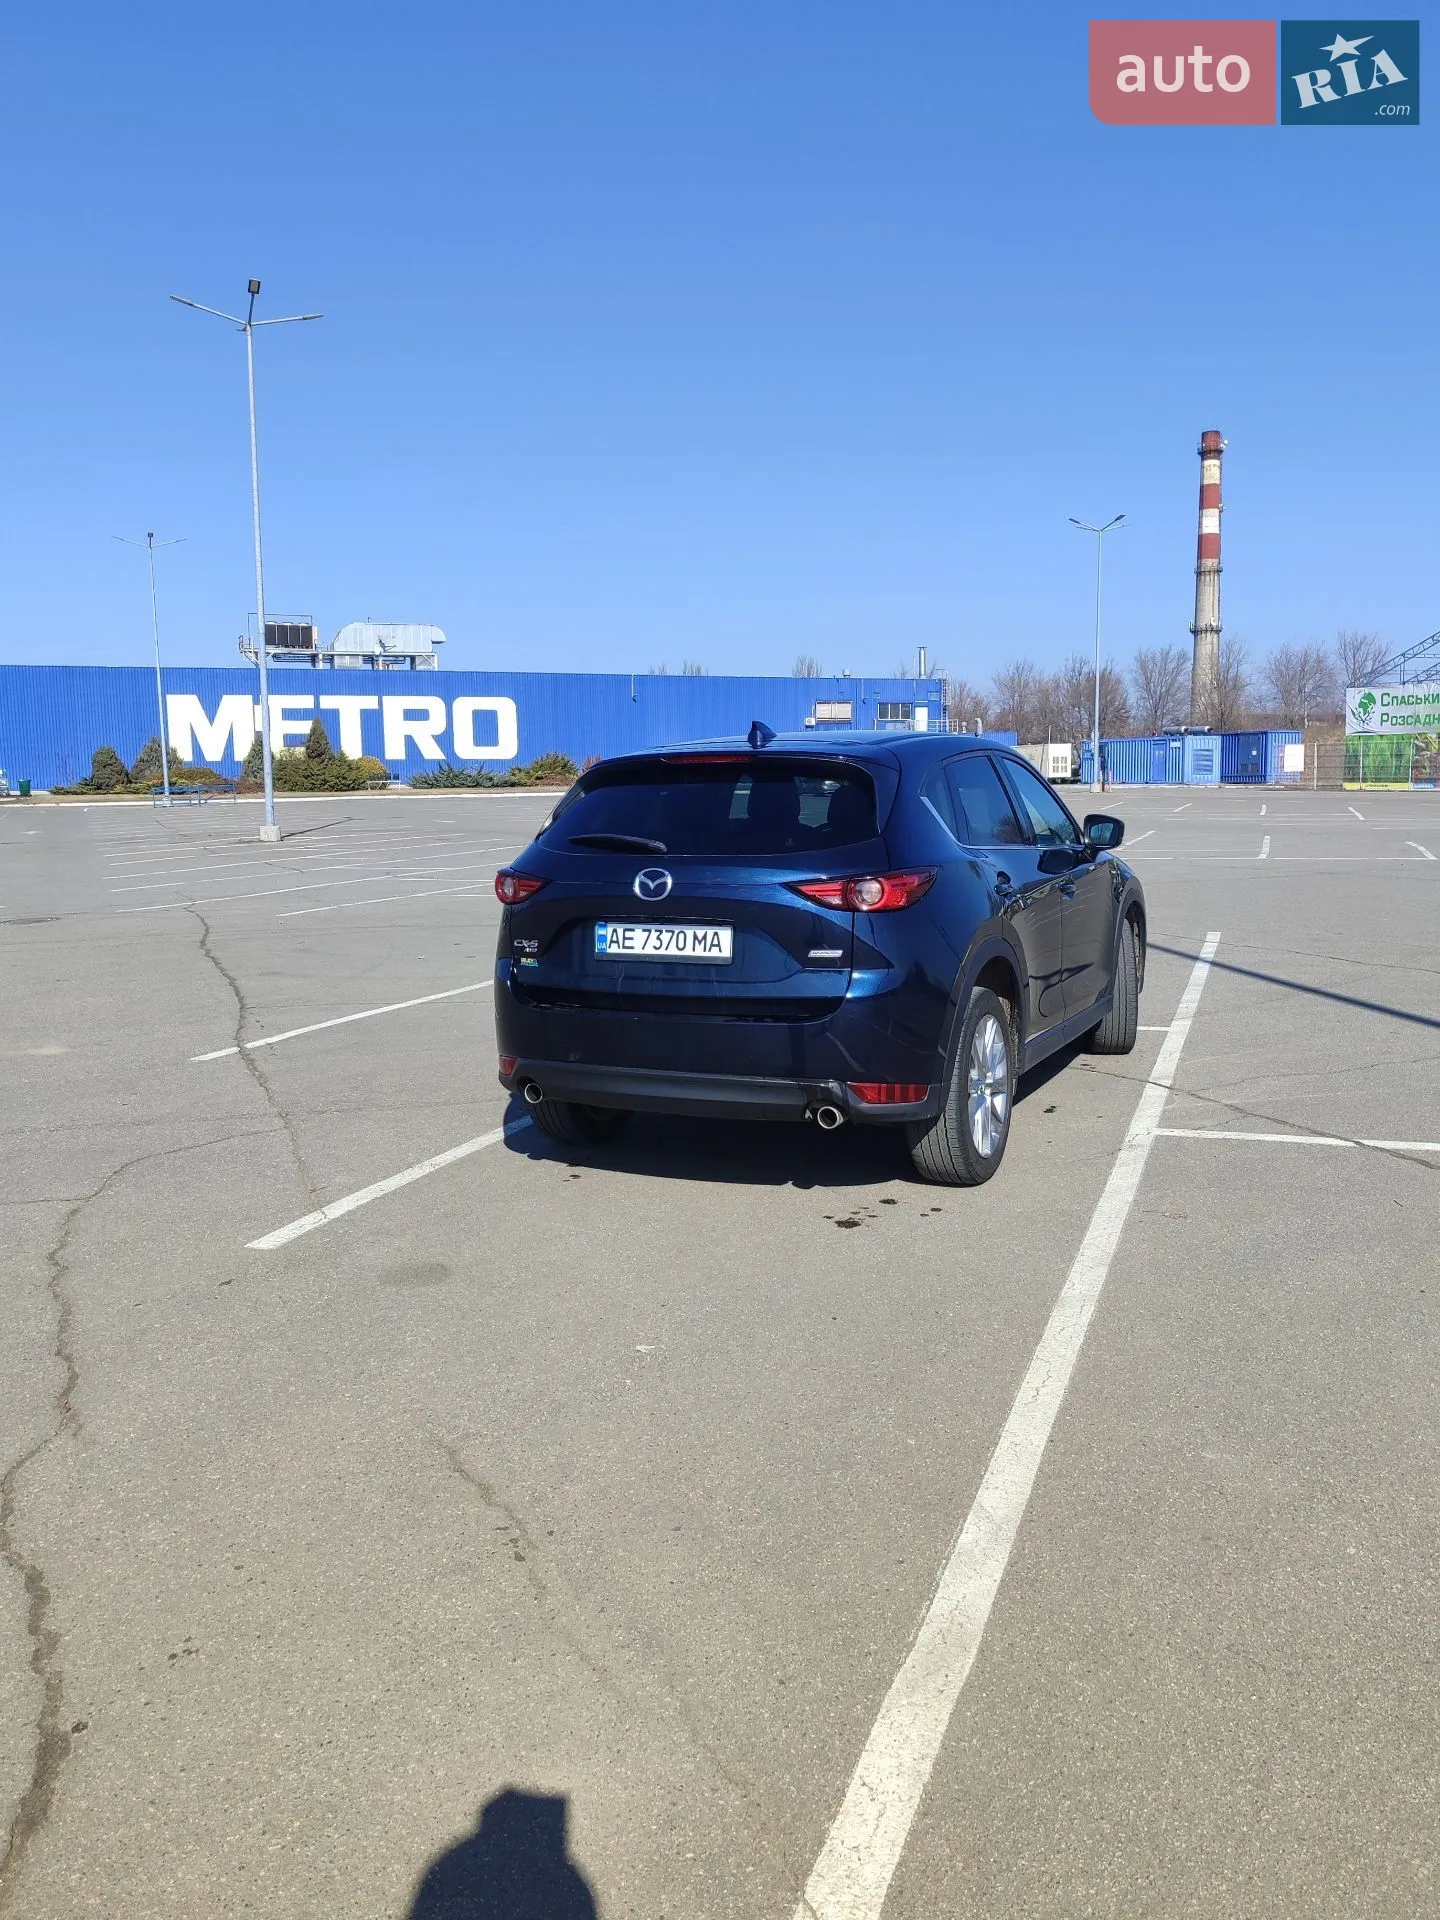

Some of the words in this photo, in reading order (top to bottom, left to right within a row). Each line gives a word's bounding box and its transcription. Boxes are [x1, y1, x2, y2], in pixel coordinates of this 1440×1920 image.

[166, 694, 518, 761] METRO
[608, 928, 635, 950] AE
[641, 929, 687, 951] 7370
[692, 930, 723, 953] MA
